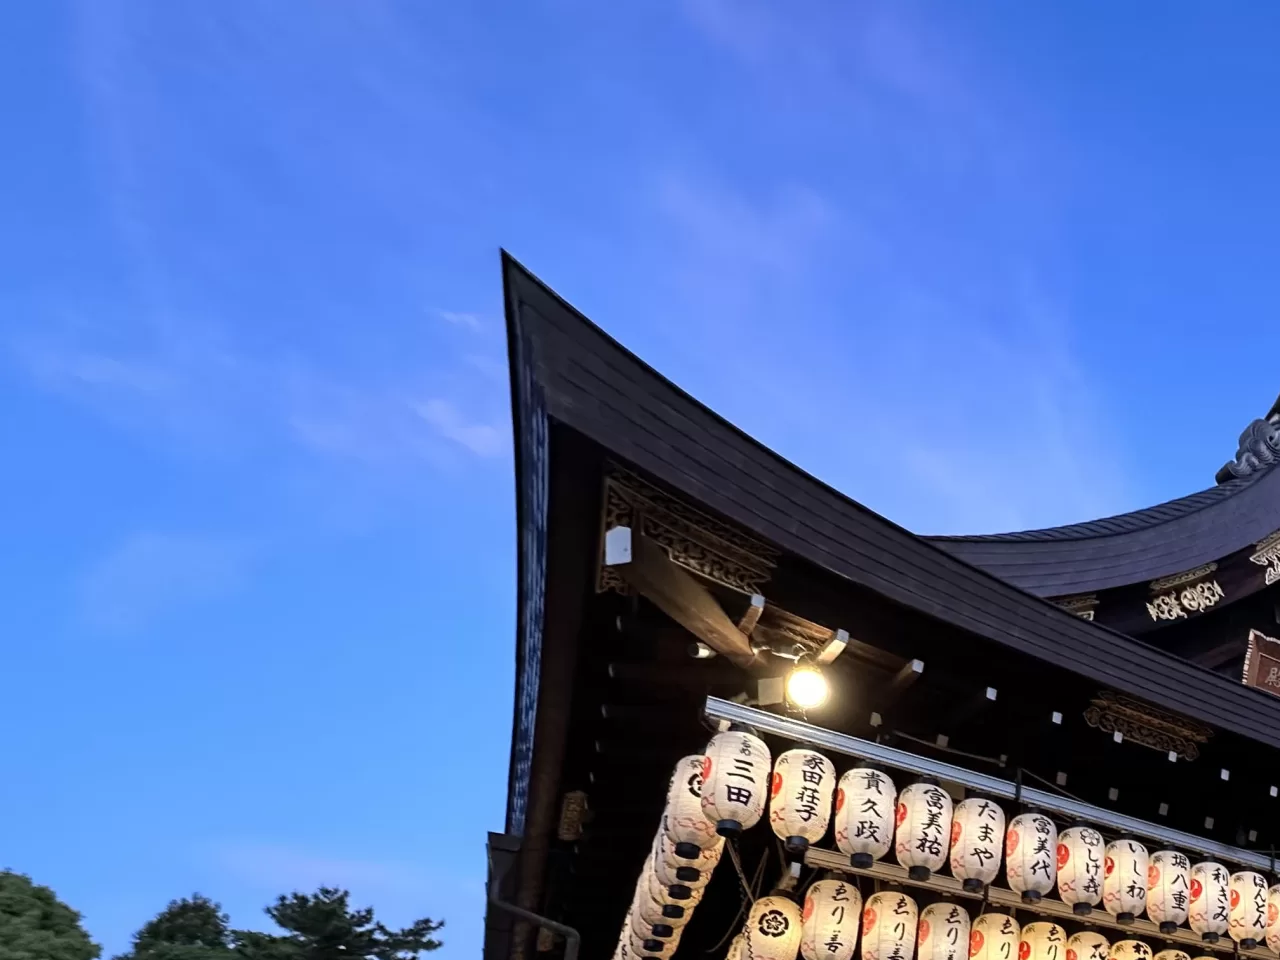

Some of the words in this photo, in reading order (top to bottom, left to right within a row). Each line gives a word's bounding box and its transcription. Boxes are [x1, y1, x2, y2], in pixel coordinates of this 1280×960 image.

[727, 758, 756, 807] 三田
[795, 755, 825, 822] 家田荘子
[970, 801, 997, 867] たまや
[1030, 817, 1052, 881] 富美代
[1171, 854, 1189, 912] 堀八重
